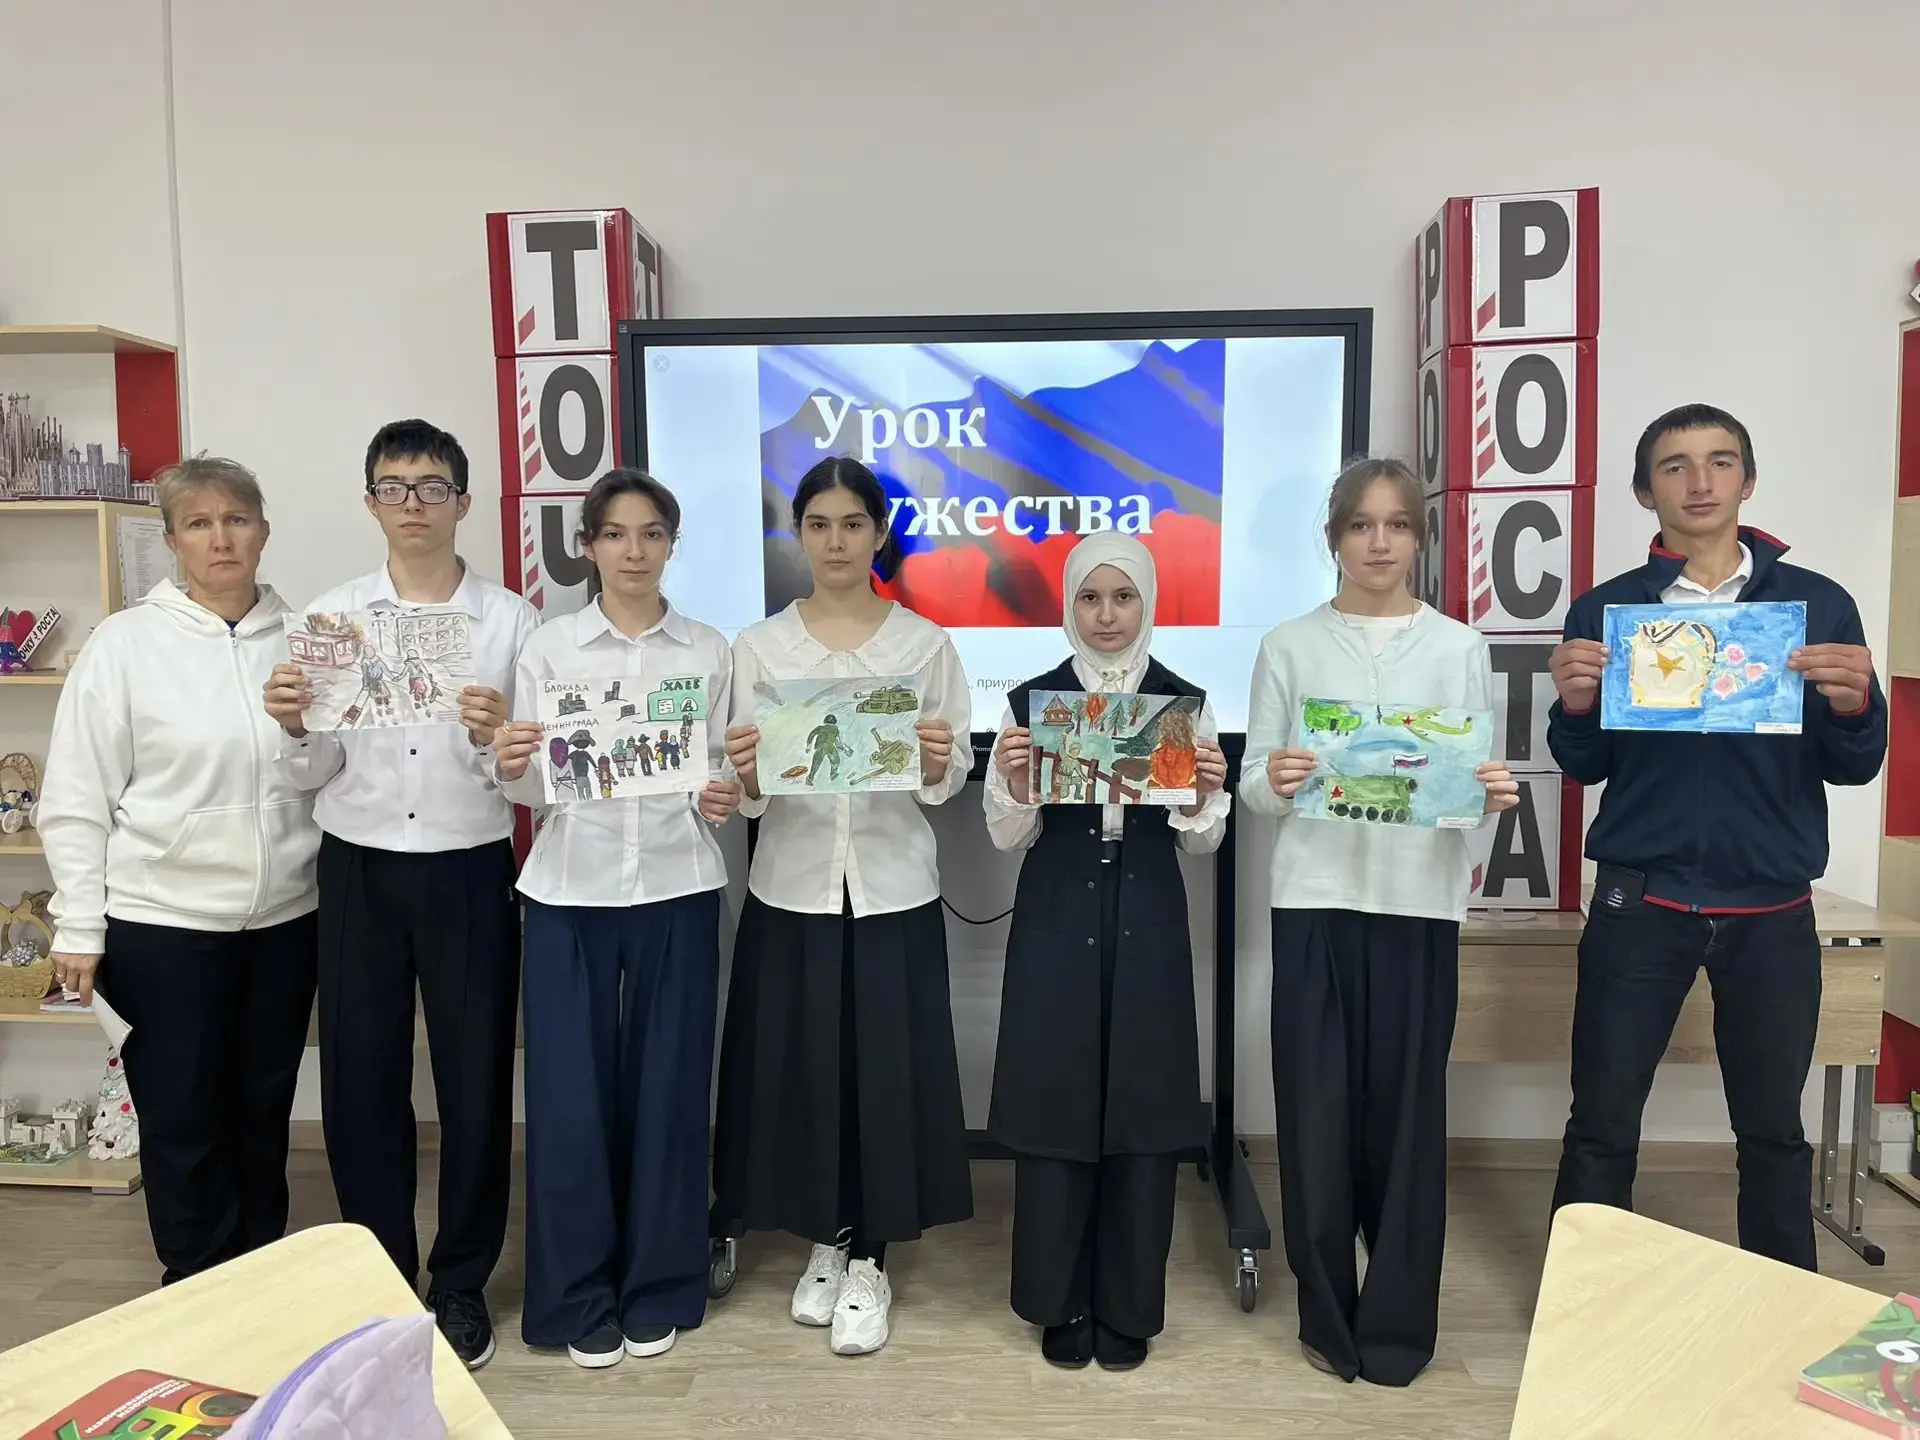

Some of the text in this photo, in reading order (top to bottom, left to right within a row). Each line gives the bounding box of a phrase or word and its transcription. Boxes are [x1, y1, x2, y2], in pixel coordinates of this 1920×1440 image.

[811, 395, 987, 464] Урок
[887, 494, 1154, 537] жества
[20, 608, 58, 660] ОЧКУ РОСТА
[663, 678, 700, 692] ХЛЕБ
[976, 678, 1026, 691] приуро
